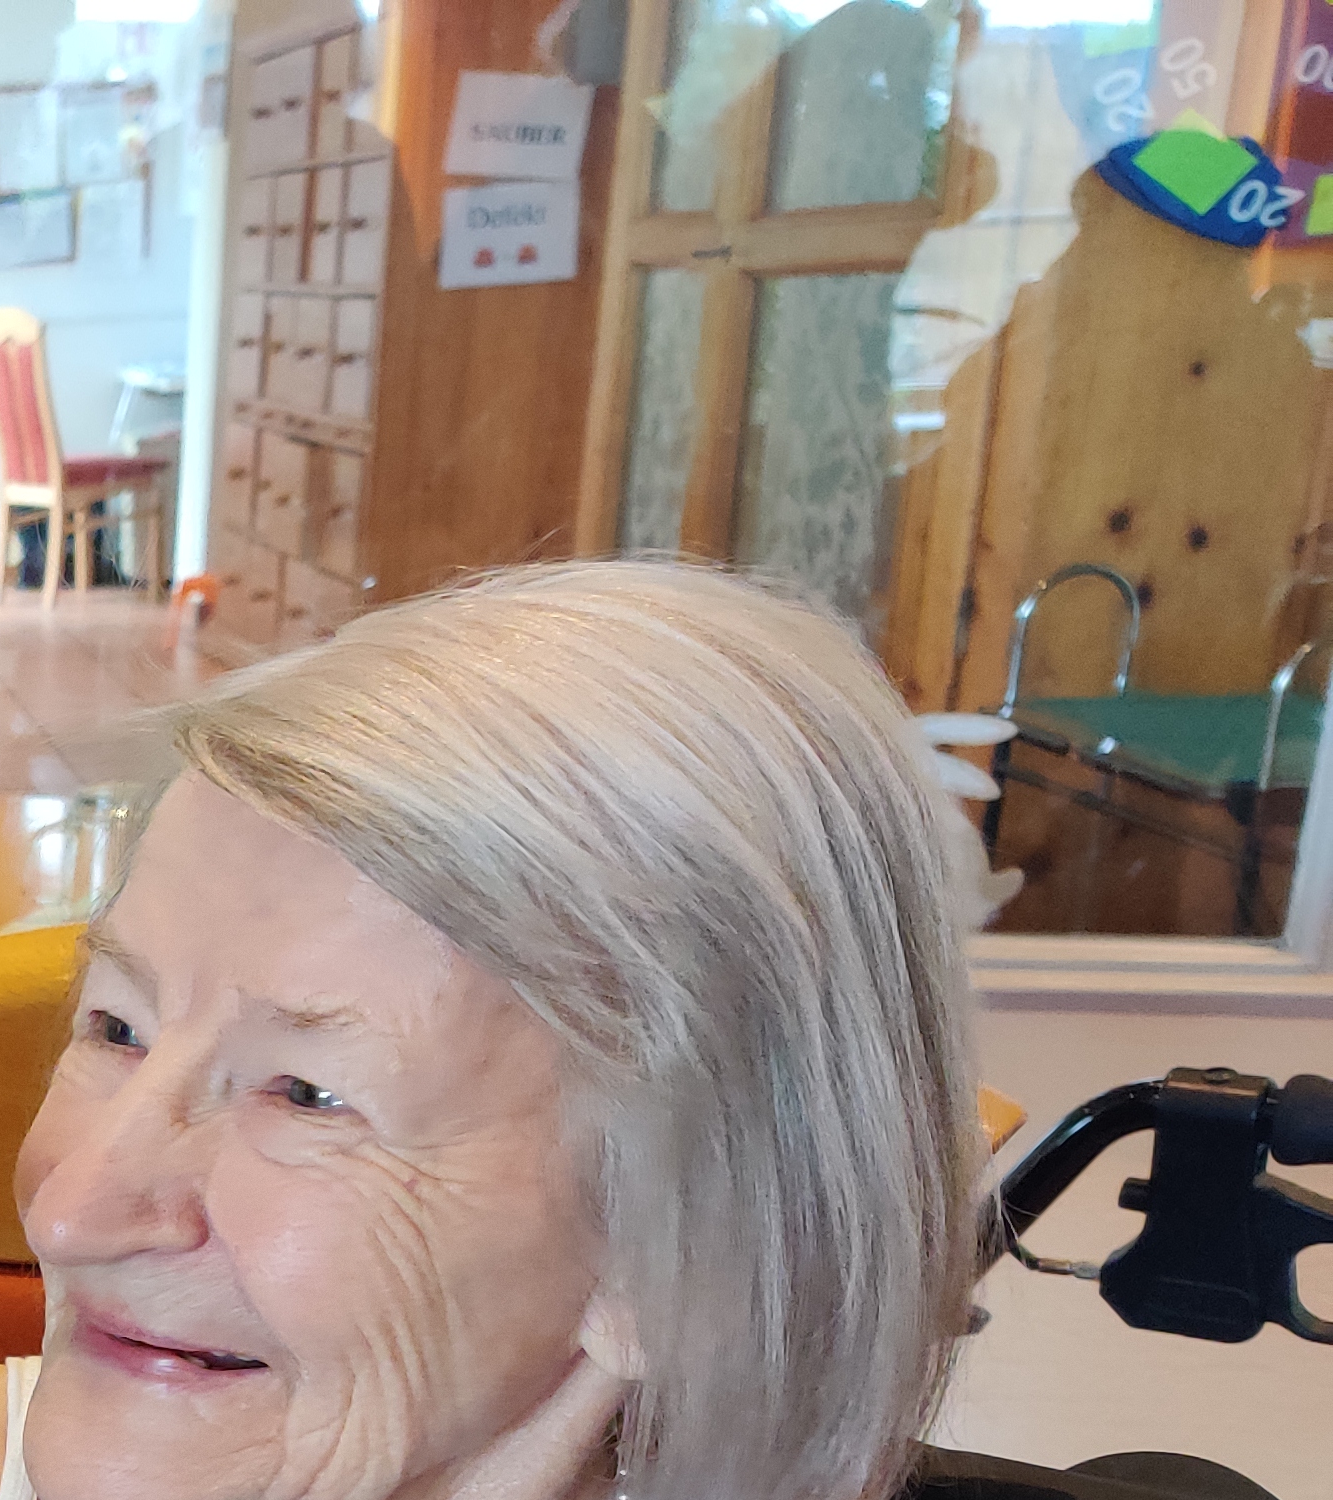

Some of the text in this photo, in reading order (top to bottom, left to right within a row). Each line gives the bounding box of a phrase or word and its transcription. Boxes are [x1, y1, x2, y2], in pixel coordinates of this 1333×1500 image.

[1160, 38, 1217, 99] 50
[1093, 67, 1154, 132] 20
[1227, 179, 1306, 229] 20
